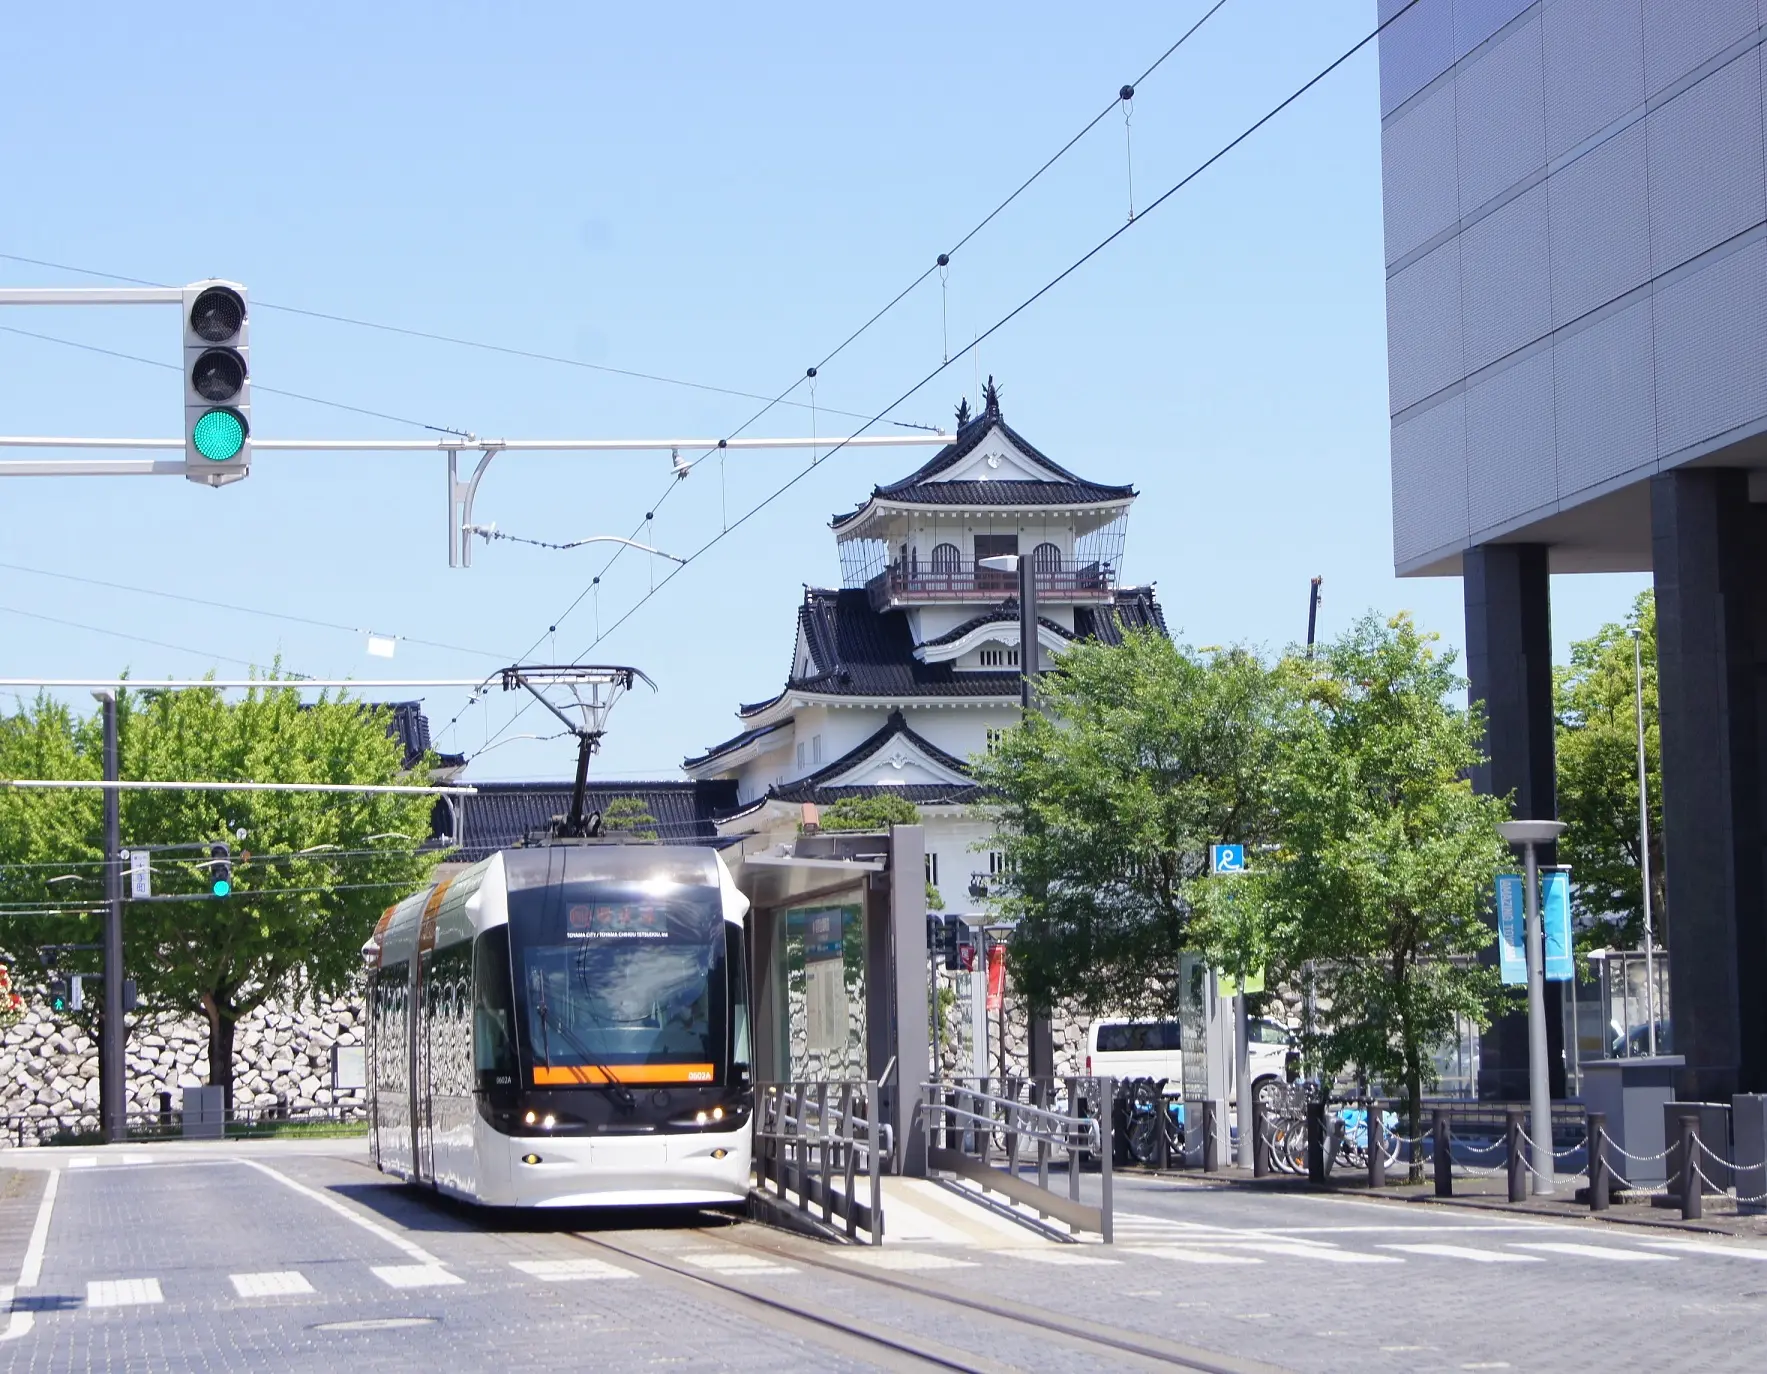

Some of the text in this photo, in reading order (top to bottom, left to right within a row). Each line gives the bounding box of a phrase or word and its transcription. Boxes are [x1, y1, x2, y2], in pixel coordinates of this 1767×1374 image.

[1501, 880, 1516, 959] AMAZING TOYA
[496, 1076, 512, 1084] 0602A
[688, 1071, 712, 1081] 0602A
